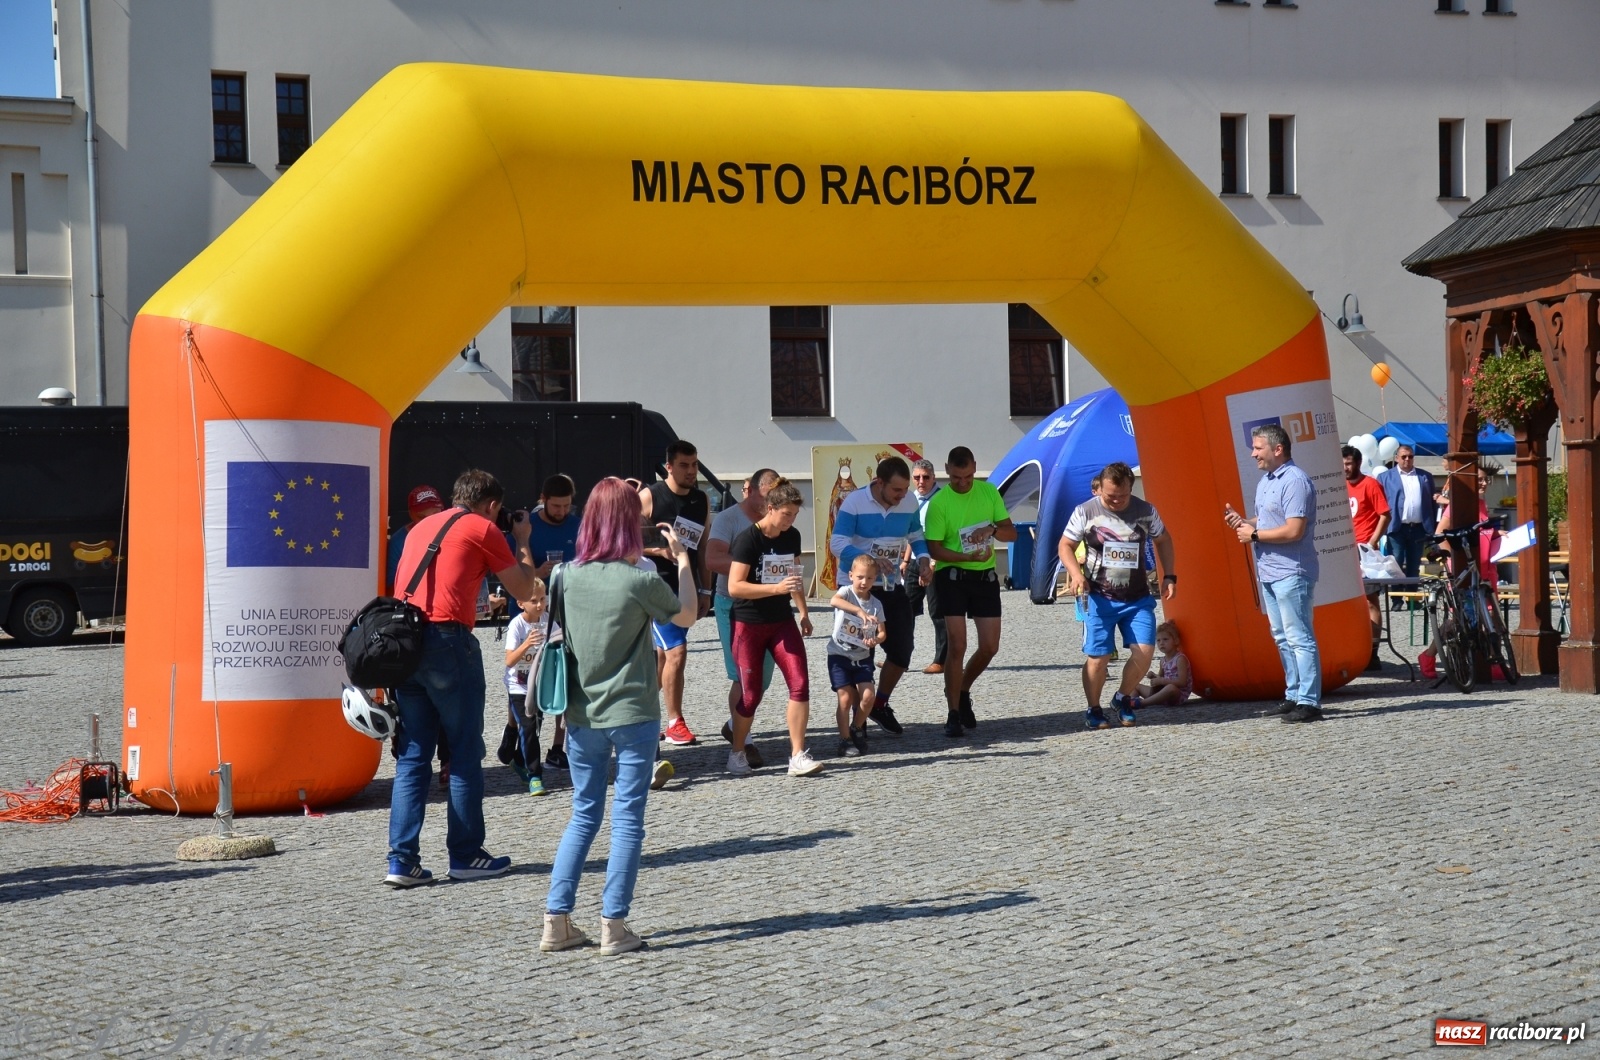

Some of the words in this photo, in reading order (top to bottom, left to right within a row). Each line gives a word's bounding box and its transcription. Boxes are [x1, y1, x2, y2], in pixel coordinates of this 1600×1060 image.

[631, 159, 806, 205] MIASTO
[820, 157, 1037, 206] RACIBÓRZ
[1111, 550, 1132, 560] 003
[9, 563, 17, 572] Z
[18, 562, 51, 572] DROGI
[240, 608, 276, 621] UNIA
[225, 624, 317, 637] EUROPEJSKI
[212, 641, 285, 653] ROZWOJU
[214, 656, 330, 668] PRZEKRACZAMY
